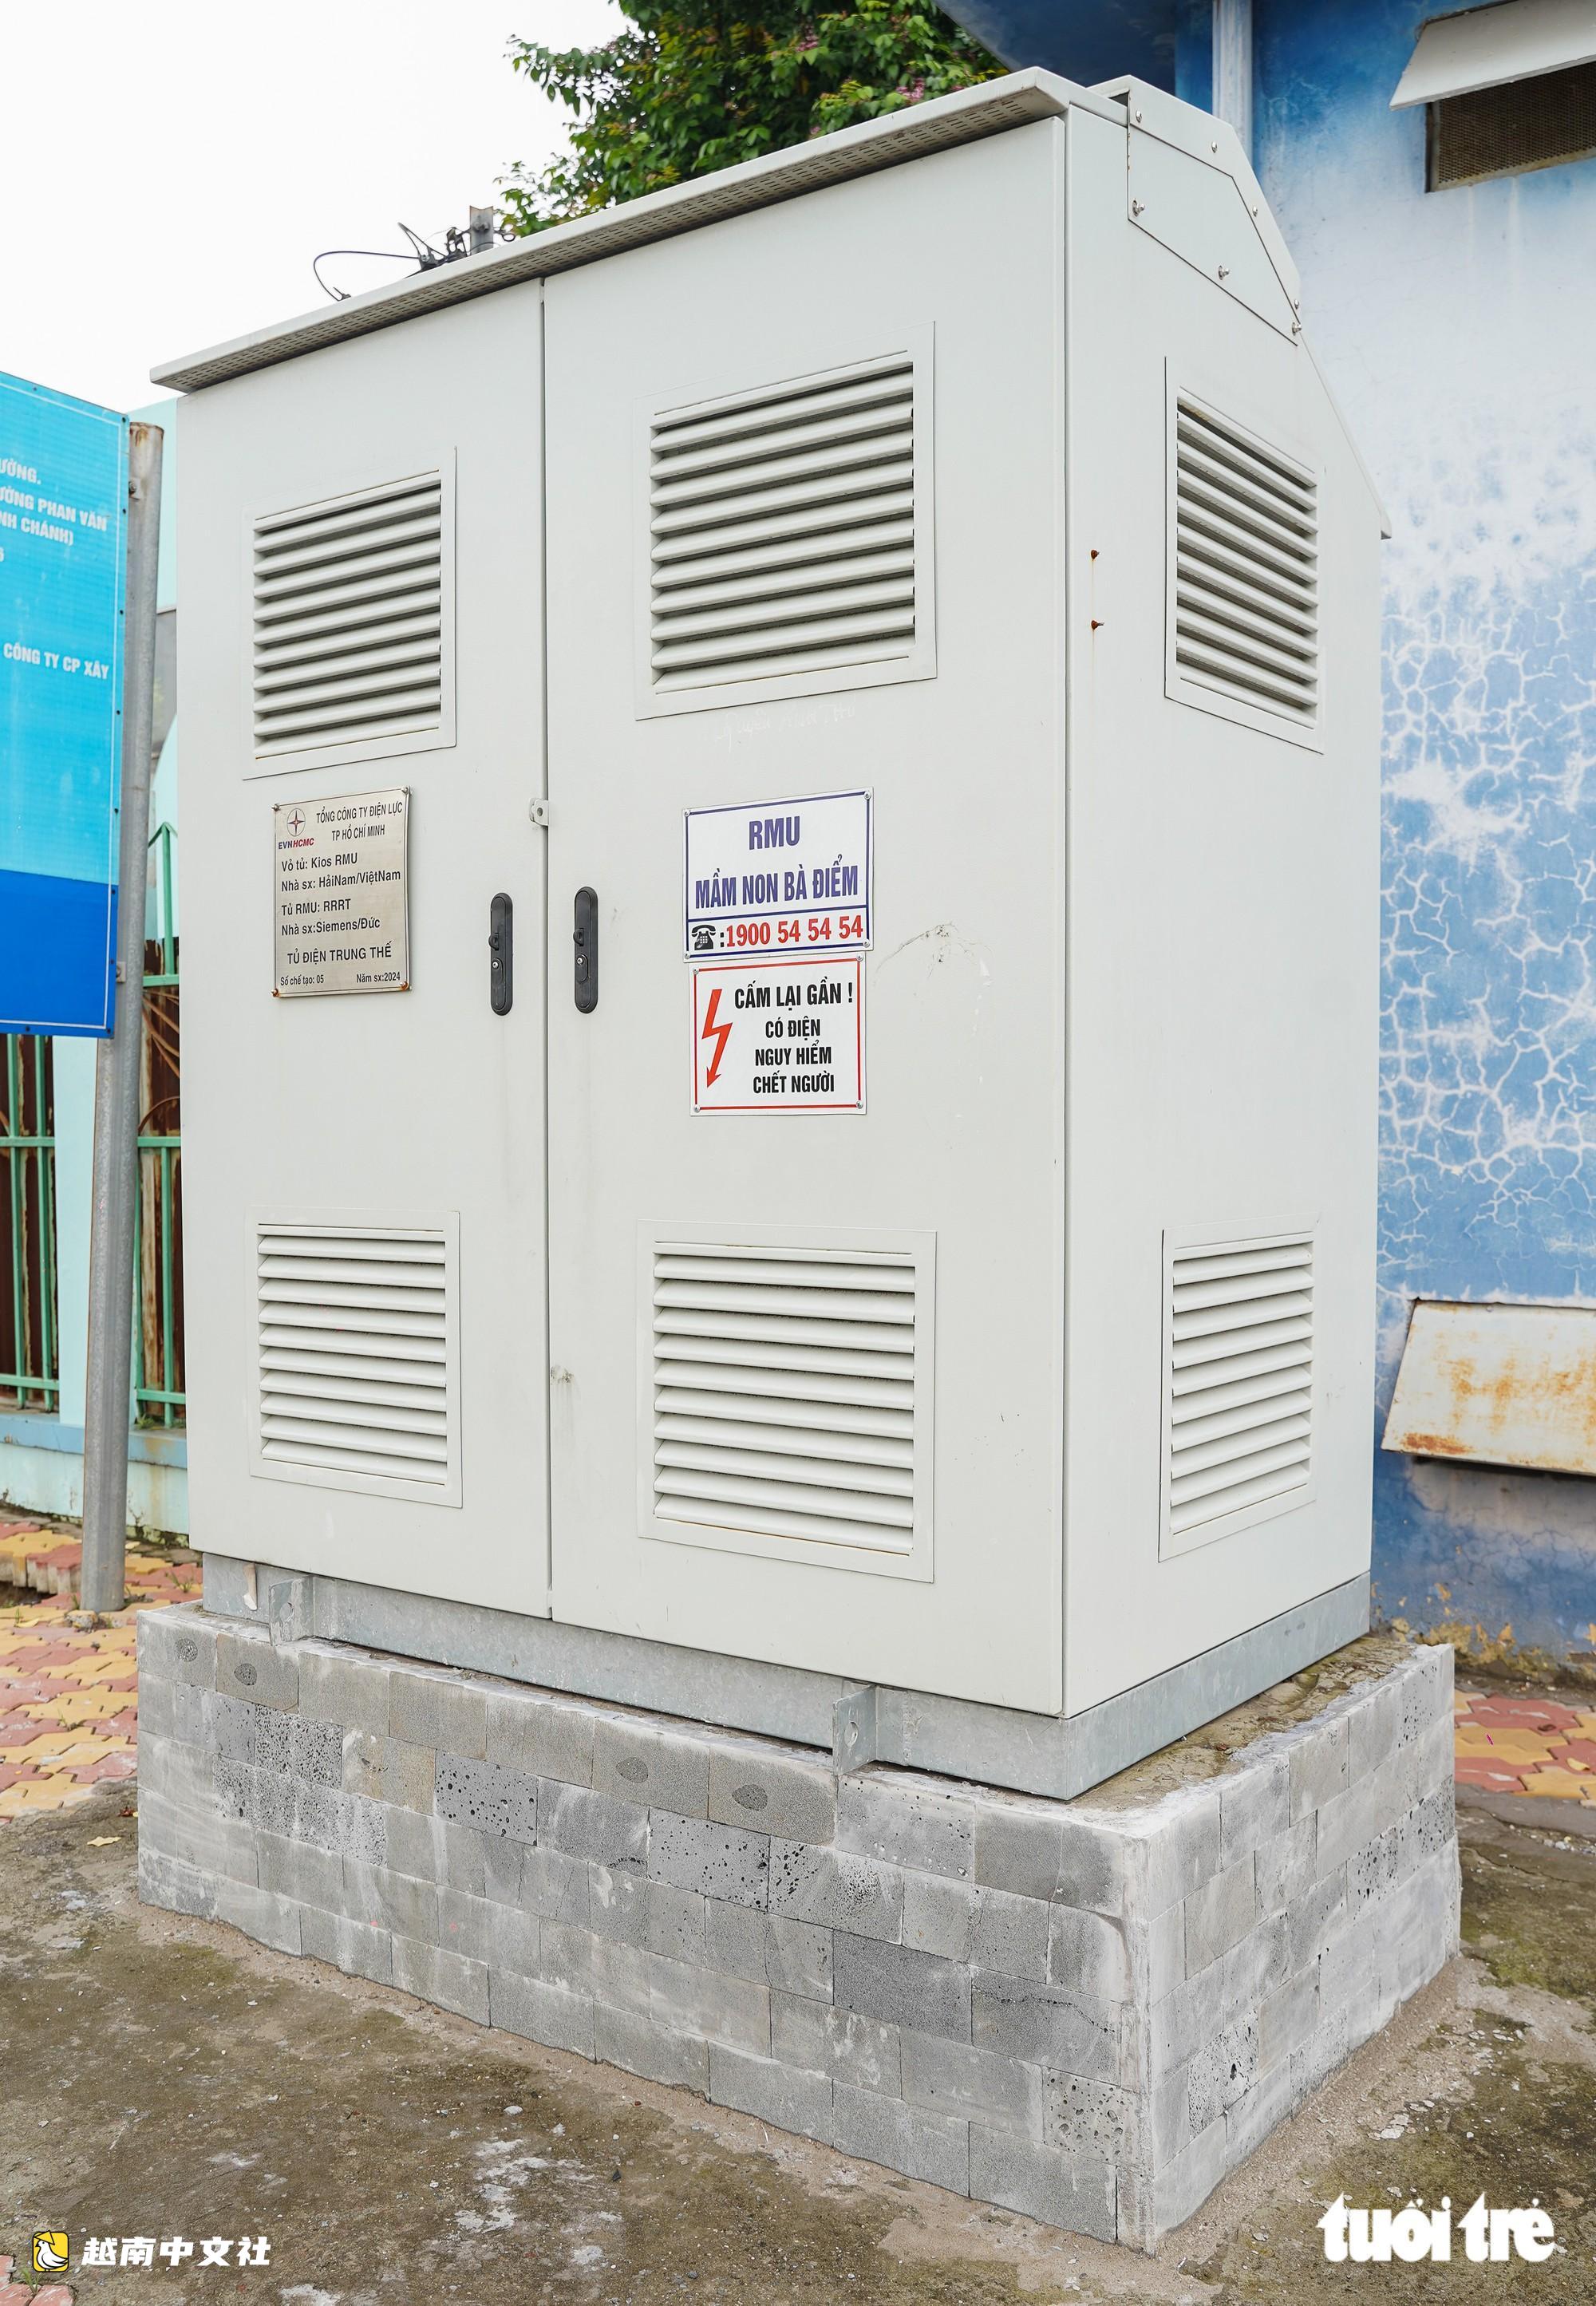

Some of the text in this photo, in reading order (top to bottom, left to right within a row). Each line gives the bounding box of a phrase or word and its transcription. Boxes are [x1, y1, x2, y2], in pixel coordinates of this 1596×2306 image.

[38, 498, 77, 523] PHAN
[79, 510, 107, 531] VĂN
[21, 517, 74, 547] CHÁNH)
[3, 642, 109, 680] CÔNG TY CP XÂY
[316, 801, 403, 824] TỔNG CÔNG TY ĐIỆN LỰC
[278, 838, 314, 850] EVNHCMC
[332, 831, 341, 842] TP
[354, 823, 366, 839] CHÍ
[367, 824, 385, 837] MINH
[749, 815, 800, 850] RMU
[281, 852, 358, 872] Vỏ tủ: Kios RMU
[281, 870, 401, 892] Nhà sx: HảiNam/ViệtNam
[695, 854, 858, 909] MẦM NON BÀ ĐIỂM
[281, 898, 351, 916] Tủ RMU: RRRT
[282, 924, 299, 936] Nhà
[777, 919, 801, 943] 54
[808, 917, 832, 942] 54
[839, 914, 863, 939] 54
[287, 940, 393, 965] TỦ ĐIỆN TRUNG THẾ
[280, 974, 324, 987] Số chế tạo: 05
[356, 973, 372, 983] Năm
[734, 980, 771, 1009] CẤM
[776, 985, 801, 1011] LẠI
[807, 976, 841, 1005] GẦN
[765, 1016, 820, 1040] CÓ ĐIỆN
[755, 1039, 832, 1066] NGUY HIỂM
[753, 1070, 835, 1093] CHẾT NGƯỜI
